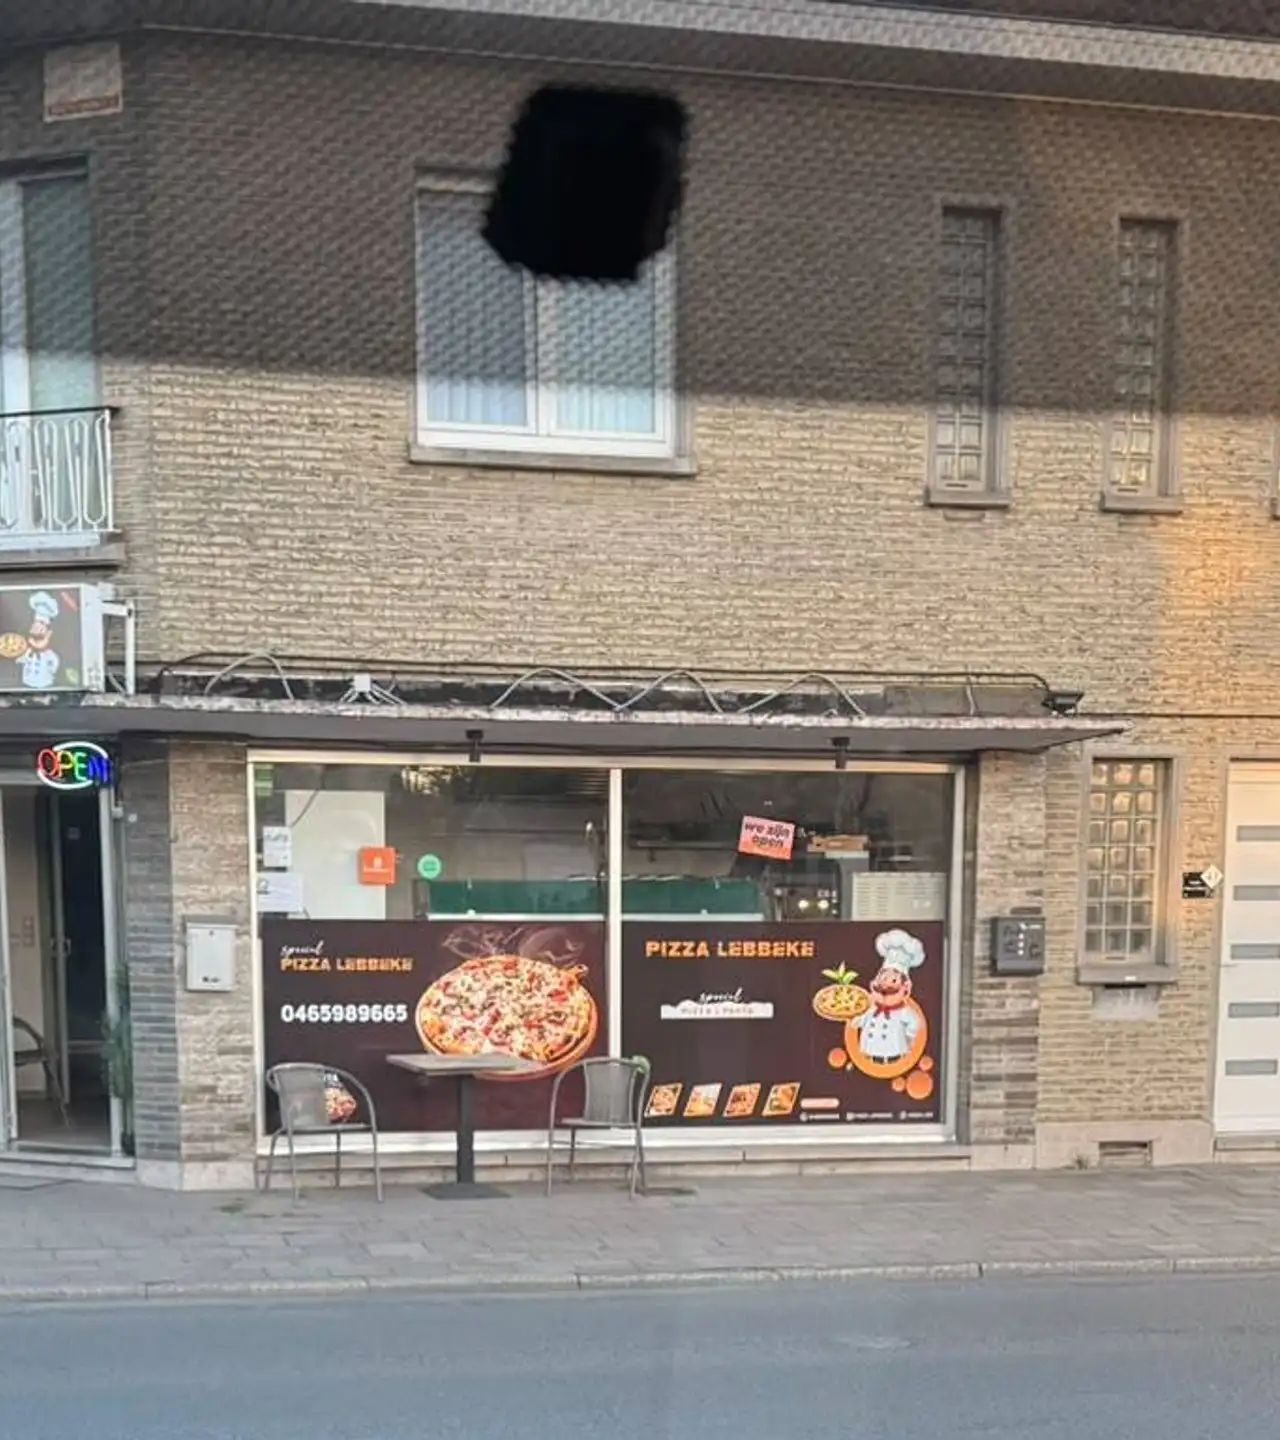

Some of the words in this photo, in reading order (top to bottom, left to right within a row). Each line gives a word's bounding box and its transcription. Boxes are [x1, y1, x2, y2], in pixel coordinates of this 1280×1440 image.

[38, 748, 109, 783] OPEN
[645, 941, 710, 957] PIZZA
[717, 941, 814, 957] LEBBEKE
[280, 958, 331, 971] PIZZA
[281, 1004, 408, 1022] 0465989665
